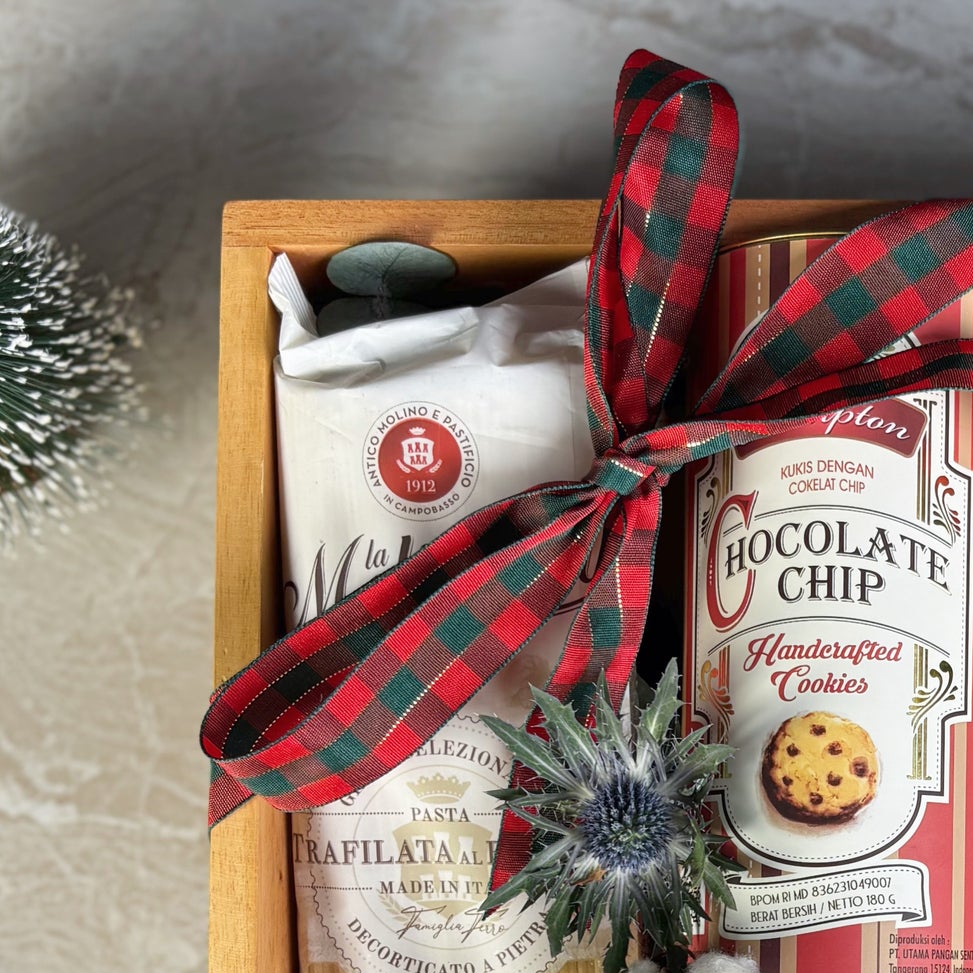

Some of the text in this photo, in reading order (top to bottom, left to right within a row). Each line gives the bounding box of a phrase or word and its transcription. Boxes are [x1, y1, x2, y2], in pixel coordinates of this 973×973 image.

[821, 405, 910, 439] pton
[366, 406, 475, 489] ANTICO MOLINO E PASTIFICIO
[780, 459, 874, 479] KUKIS DENGAN
[406, 479, 436, 493] 1912
[789, 478, 865, 495] COKELAT CHIP
[383, 493, 460, 515] IN CAMPOBASSO
[778, 565, 886, 605] CHIP
[744, 633, 901, 671] Handcrafted
[771, 665, 868, 701] Cookies
[409, 739, 511, 779] ELEZION
[411, 808, 470, 822] PASTA
[293, 833, 451, 865] TRAFILATA
[453, 850, 483, 865] AL
[380, 881, 434, 894] MADE
[439, 881, 458, 893] IN
[750, 895, 780, 906] BPOM
[782, 893, 791, 902] RI
[794, 890, 808, 900] MD
[751, 894, 895, 922] BERAT BERSIH NETTO 180 G
[889, 934, 945, 946] Diproduksi oleh
[903, 949, 929, 959] UTAMA
[931, 950, 958, 960] PANGAN
